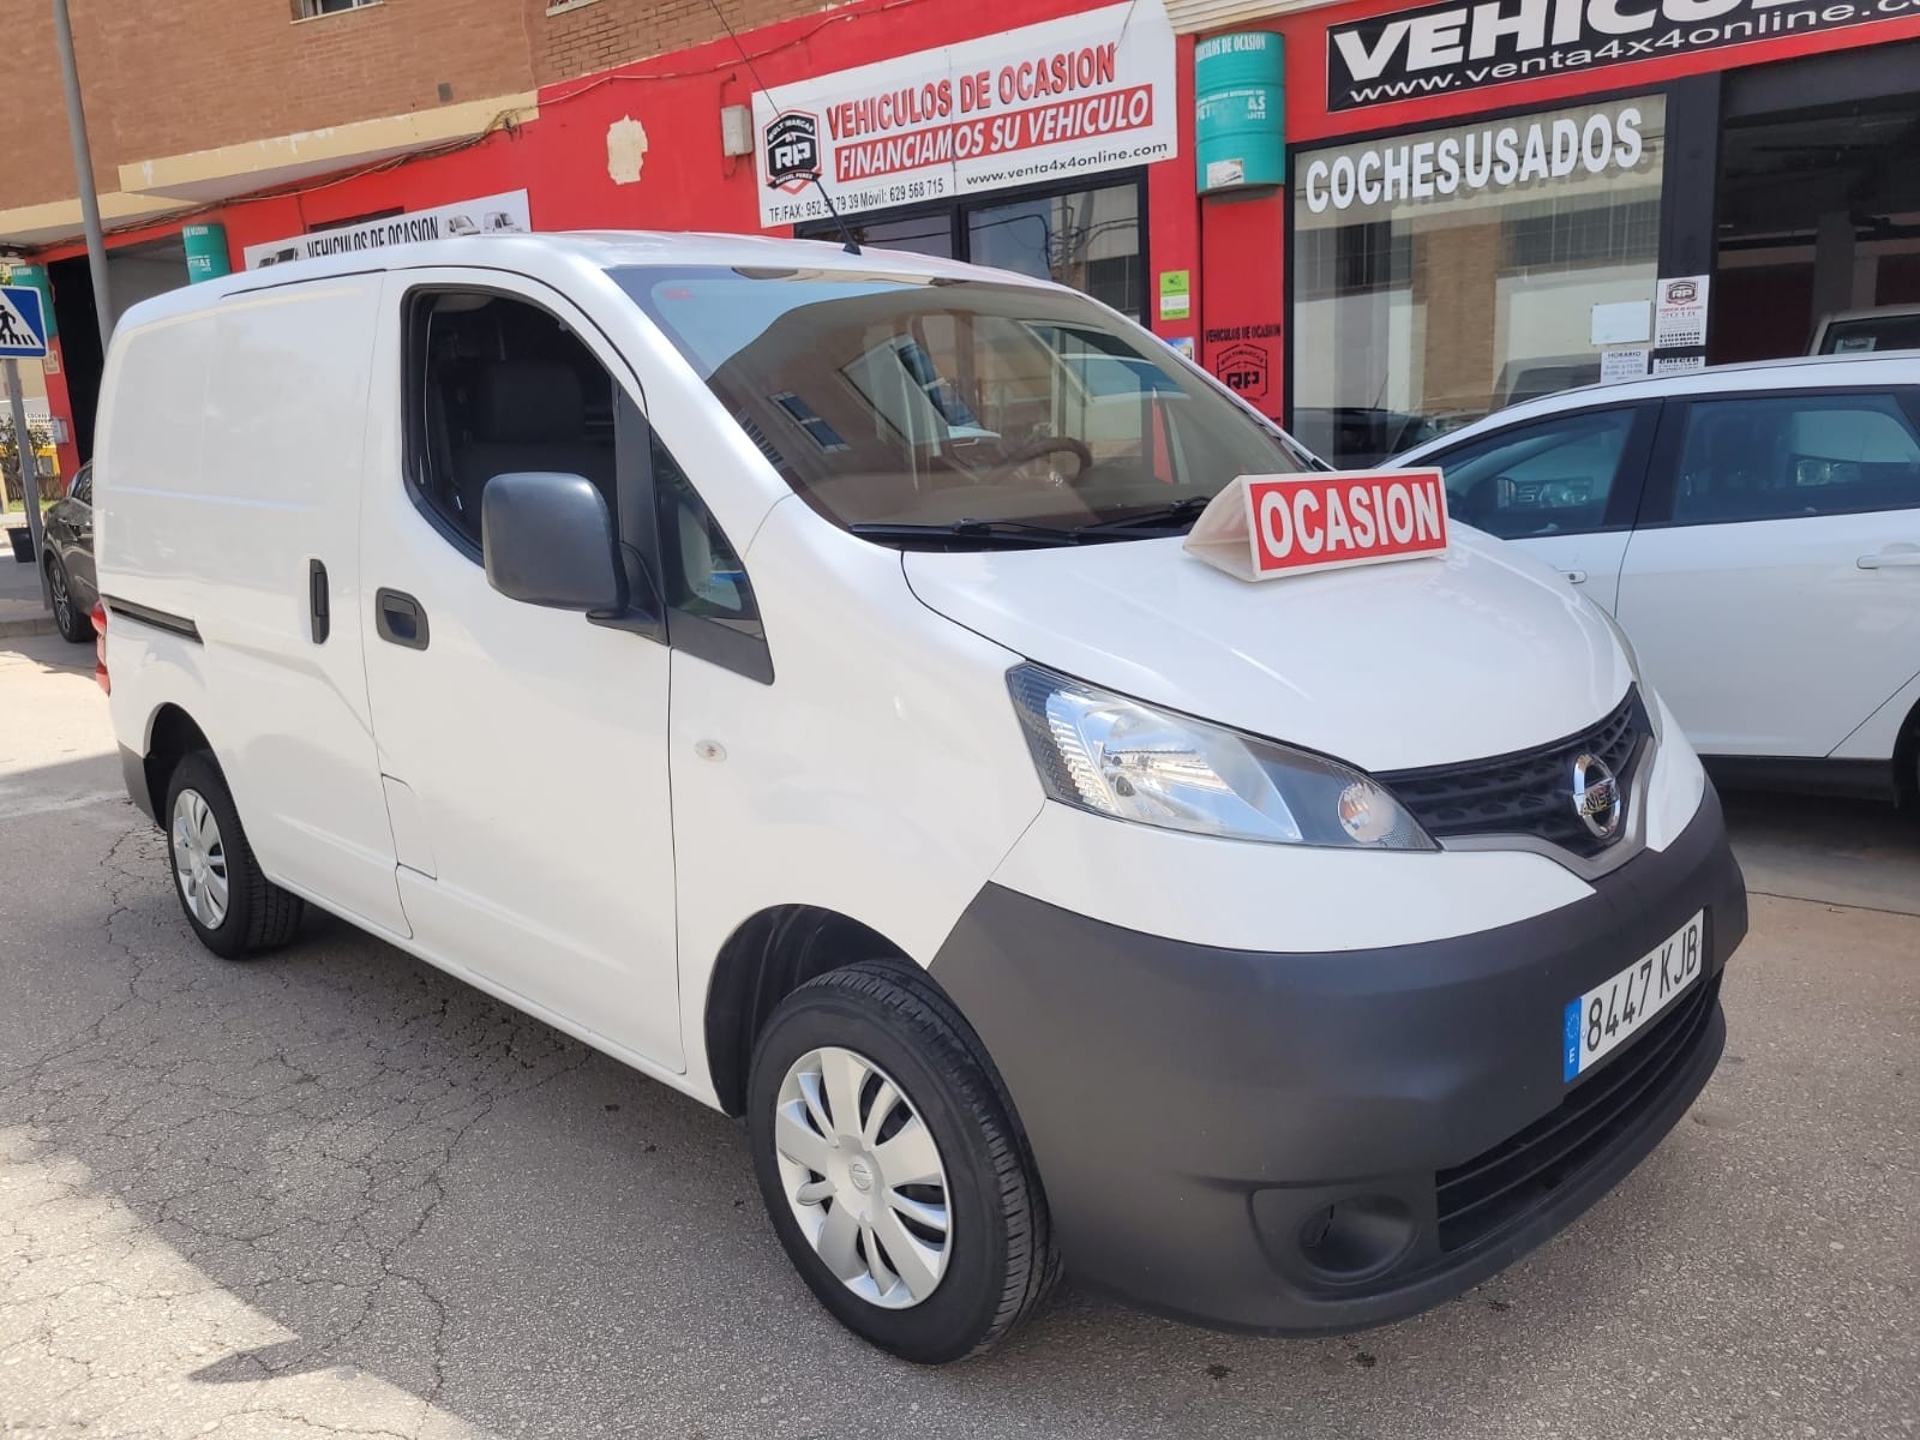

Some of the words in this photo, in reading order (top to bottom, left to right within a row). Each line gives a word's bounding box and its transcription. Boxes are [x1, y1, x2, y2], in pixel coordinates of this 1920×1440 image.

[1222, 36, 1232, 54] DE
[1234, 32, 1266, 51] OCASION
[1333, 0, 1797, 82] VEHIC
[1350, 0, 1920, 103] www.venta4x4online.c
[827, 79, 953, 141] VEHICULOS
[960, 70, 991, 113] DE
[1000, 42, 1116, 106] OCASION
[775, 142, 811, 170] RP
[839, 122, 984, 181] FINANCIAMOS
[990, 113, 1021, 150] SU
[1028, 89, 1149, 144] VEHICULO
[966, 143, 1168, 186] www.venta4x4online.com
[806, 200, 822, 217] 952
[824, 198, 833, 214] 5
[836, 195, 847, 212] 79
[848, 193, 859, 210] 39
[890, 185, 906, 202] 629
[909, 181, 925, 198] 568
[927, 178, 944, 195] 715
[1260, 481, 1441, 559] OCASION
[1586, 957, 1654, 1053] 8447
[1658, 923, 1698, 1000] KJB
[1568, 1047, 1575, 1065] E
